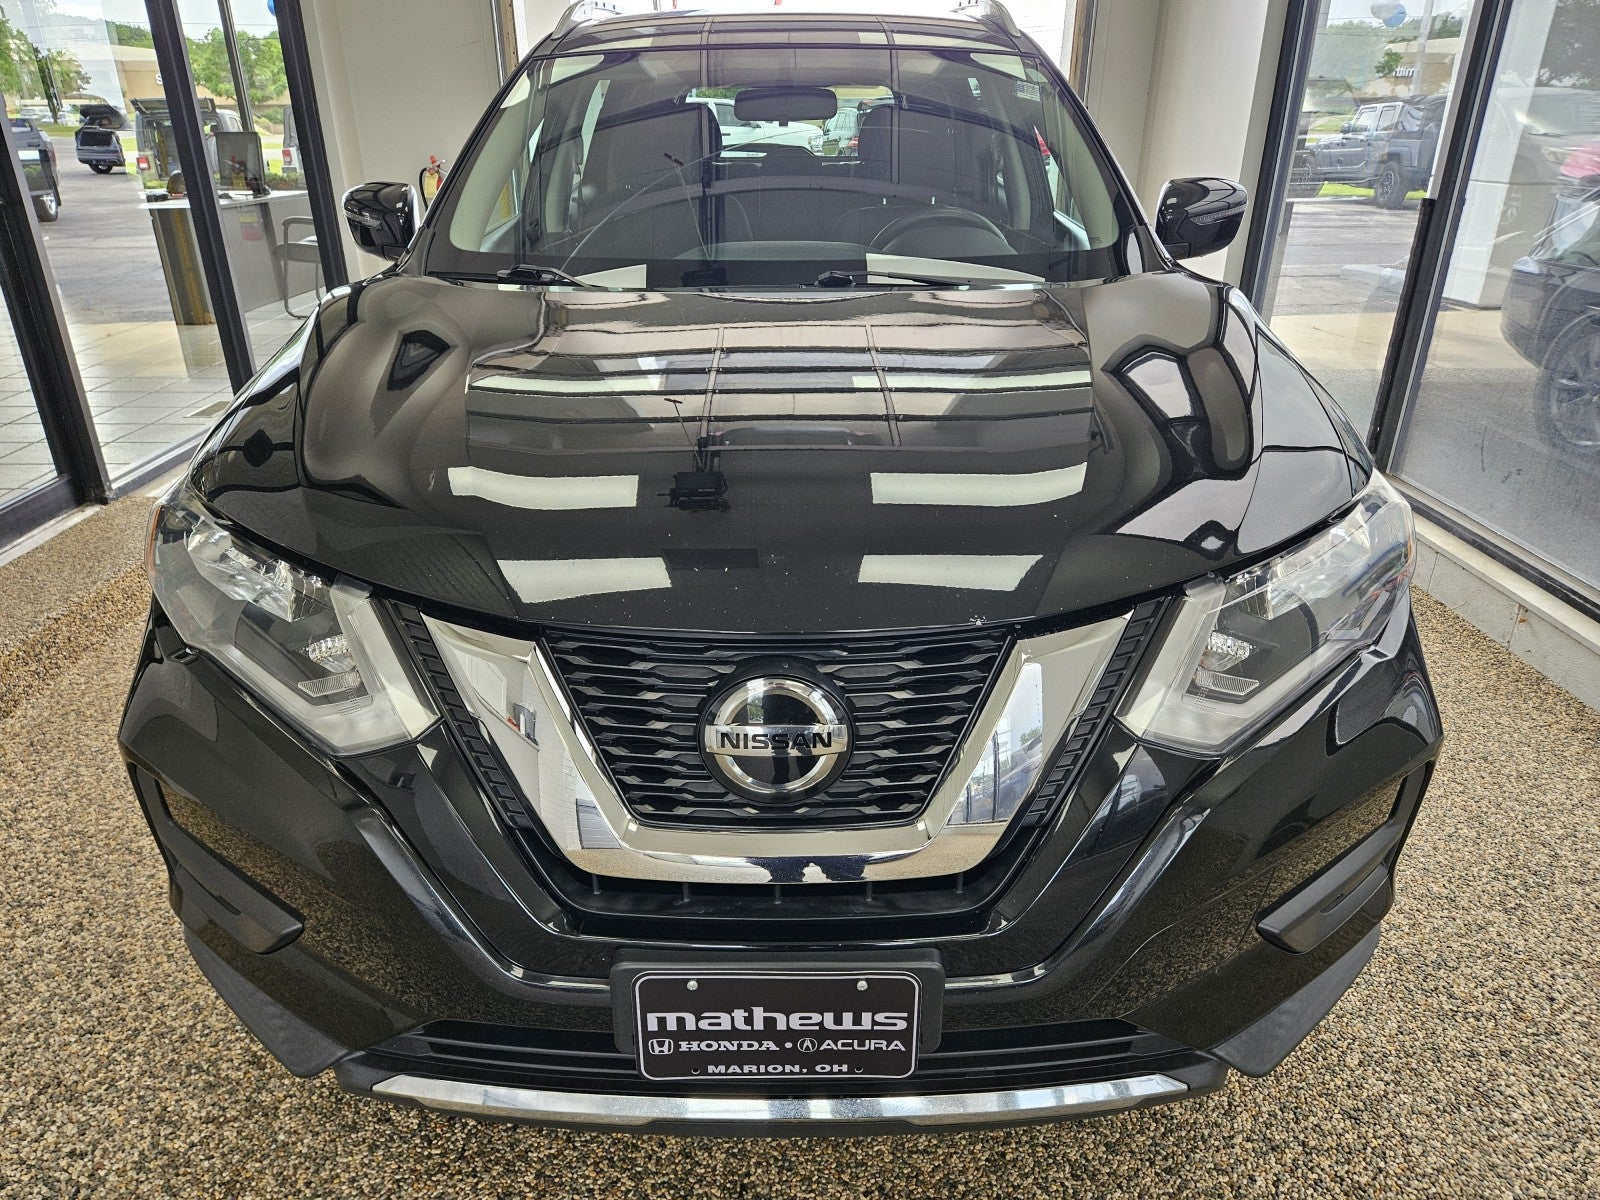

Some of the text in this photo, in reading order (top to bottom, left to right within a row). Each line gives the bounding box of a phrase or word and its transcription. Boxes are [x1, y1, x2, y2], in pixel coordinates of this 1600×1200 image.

[720, 732, 832, 750] NISSAN
[646, 1006, 908, 1032] mathews
[678, 1040, 780, 1051] HONDA
[819, 1039, 906, 1051] ACURA
[707, 1064, 848, 1074] MARION, OH
